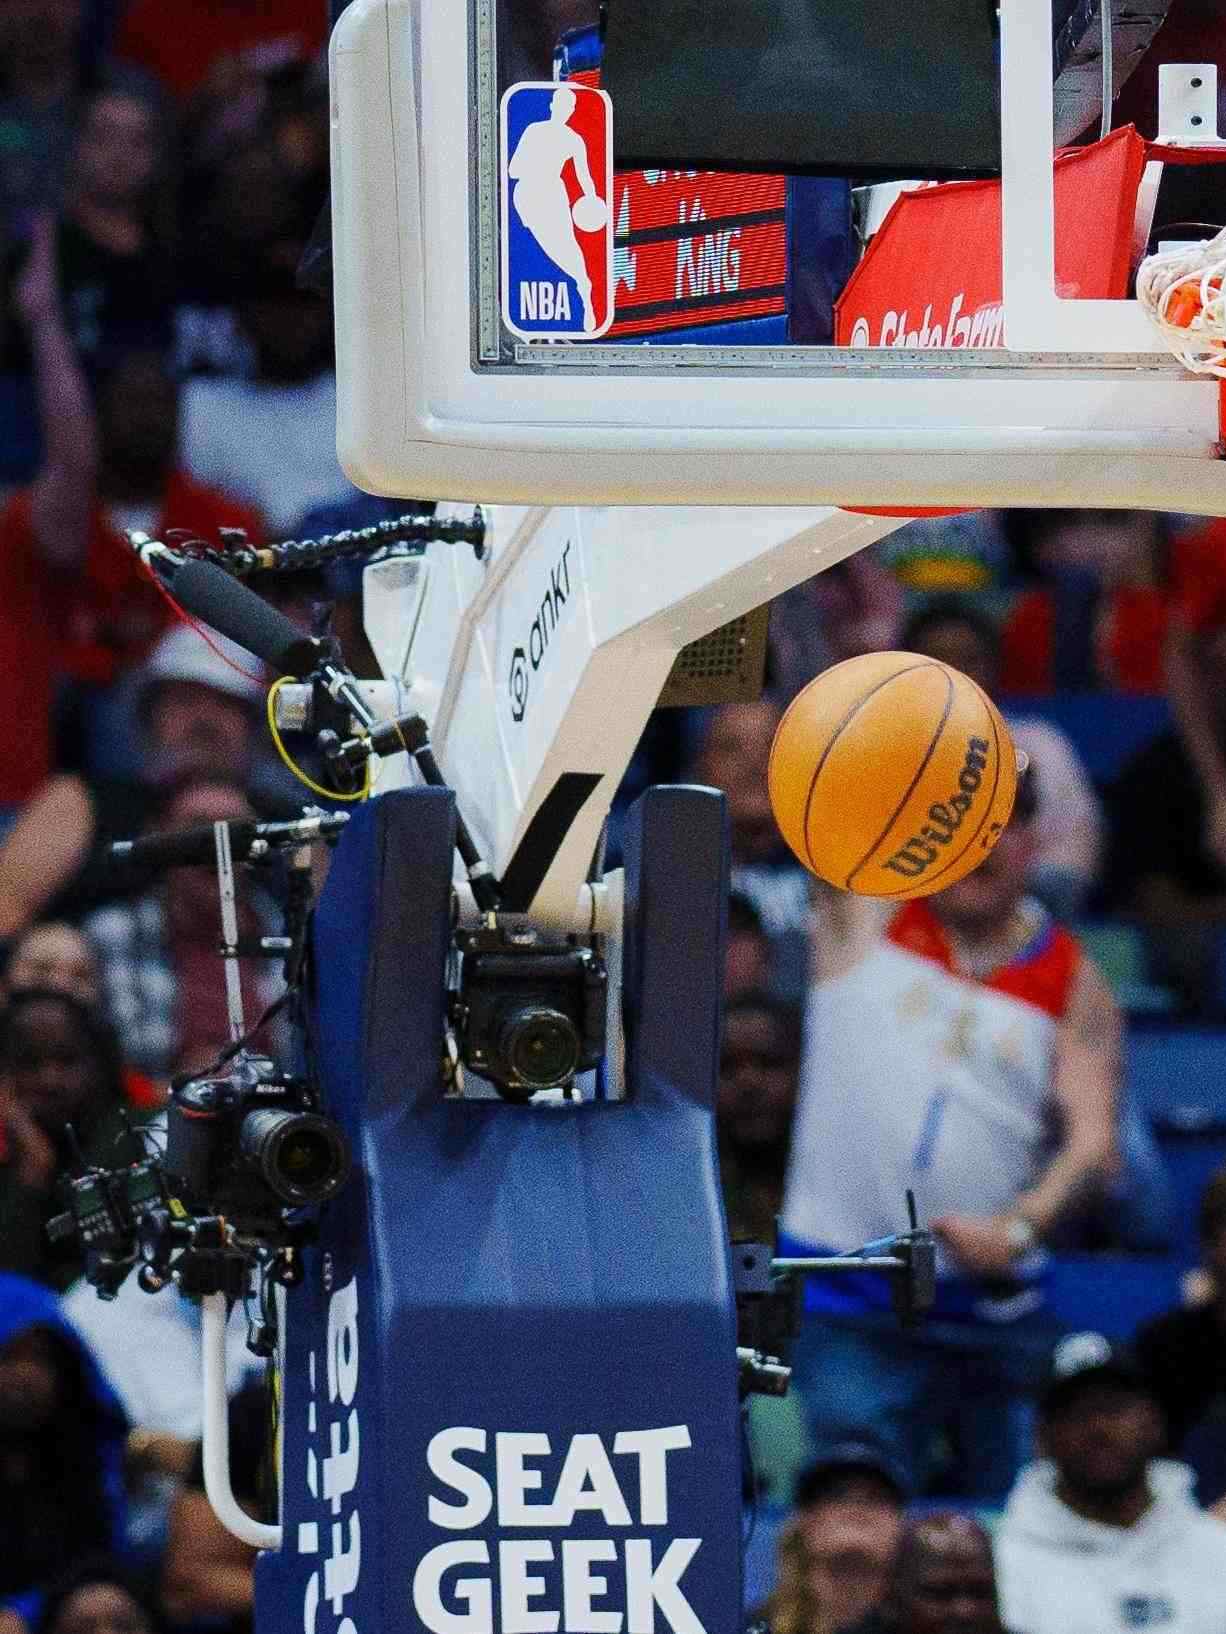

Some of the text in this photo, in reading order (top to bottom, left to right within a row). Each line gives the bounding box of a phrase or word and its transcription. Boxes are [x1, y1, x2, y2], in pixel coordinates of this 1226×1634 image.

[520, 281, 571, 320] NBA
[530, 539, 570, 671] ankr
[882, 735, 989, 877] Wilson
[426, 1424, 692, 1530] SEAT
[412, 1538, 707, 1634] GEEK
